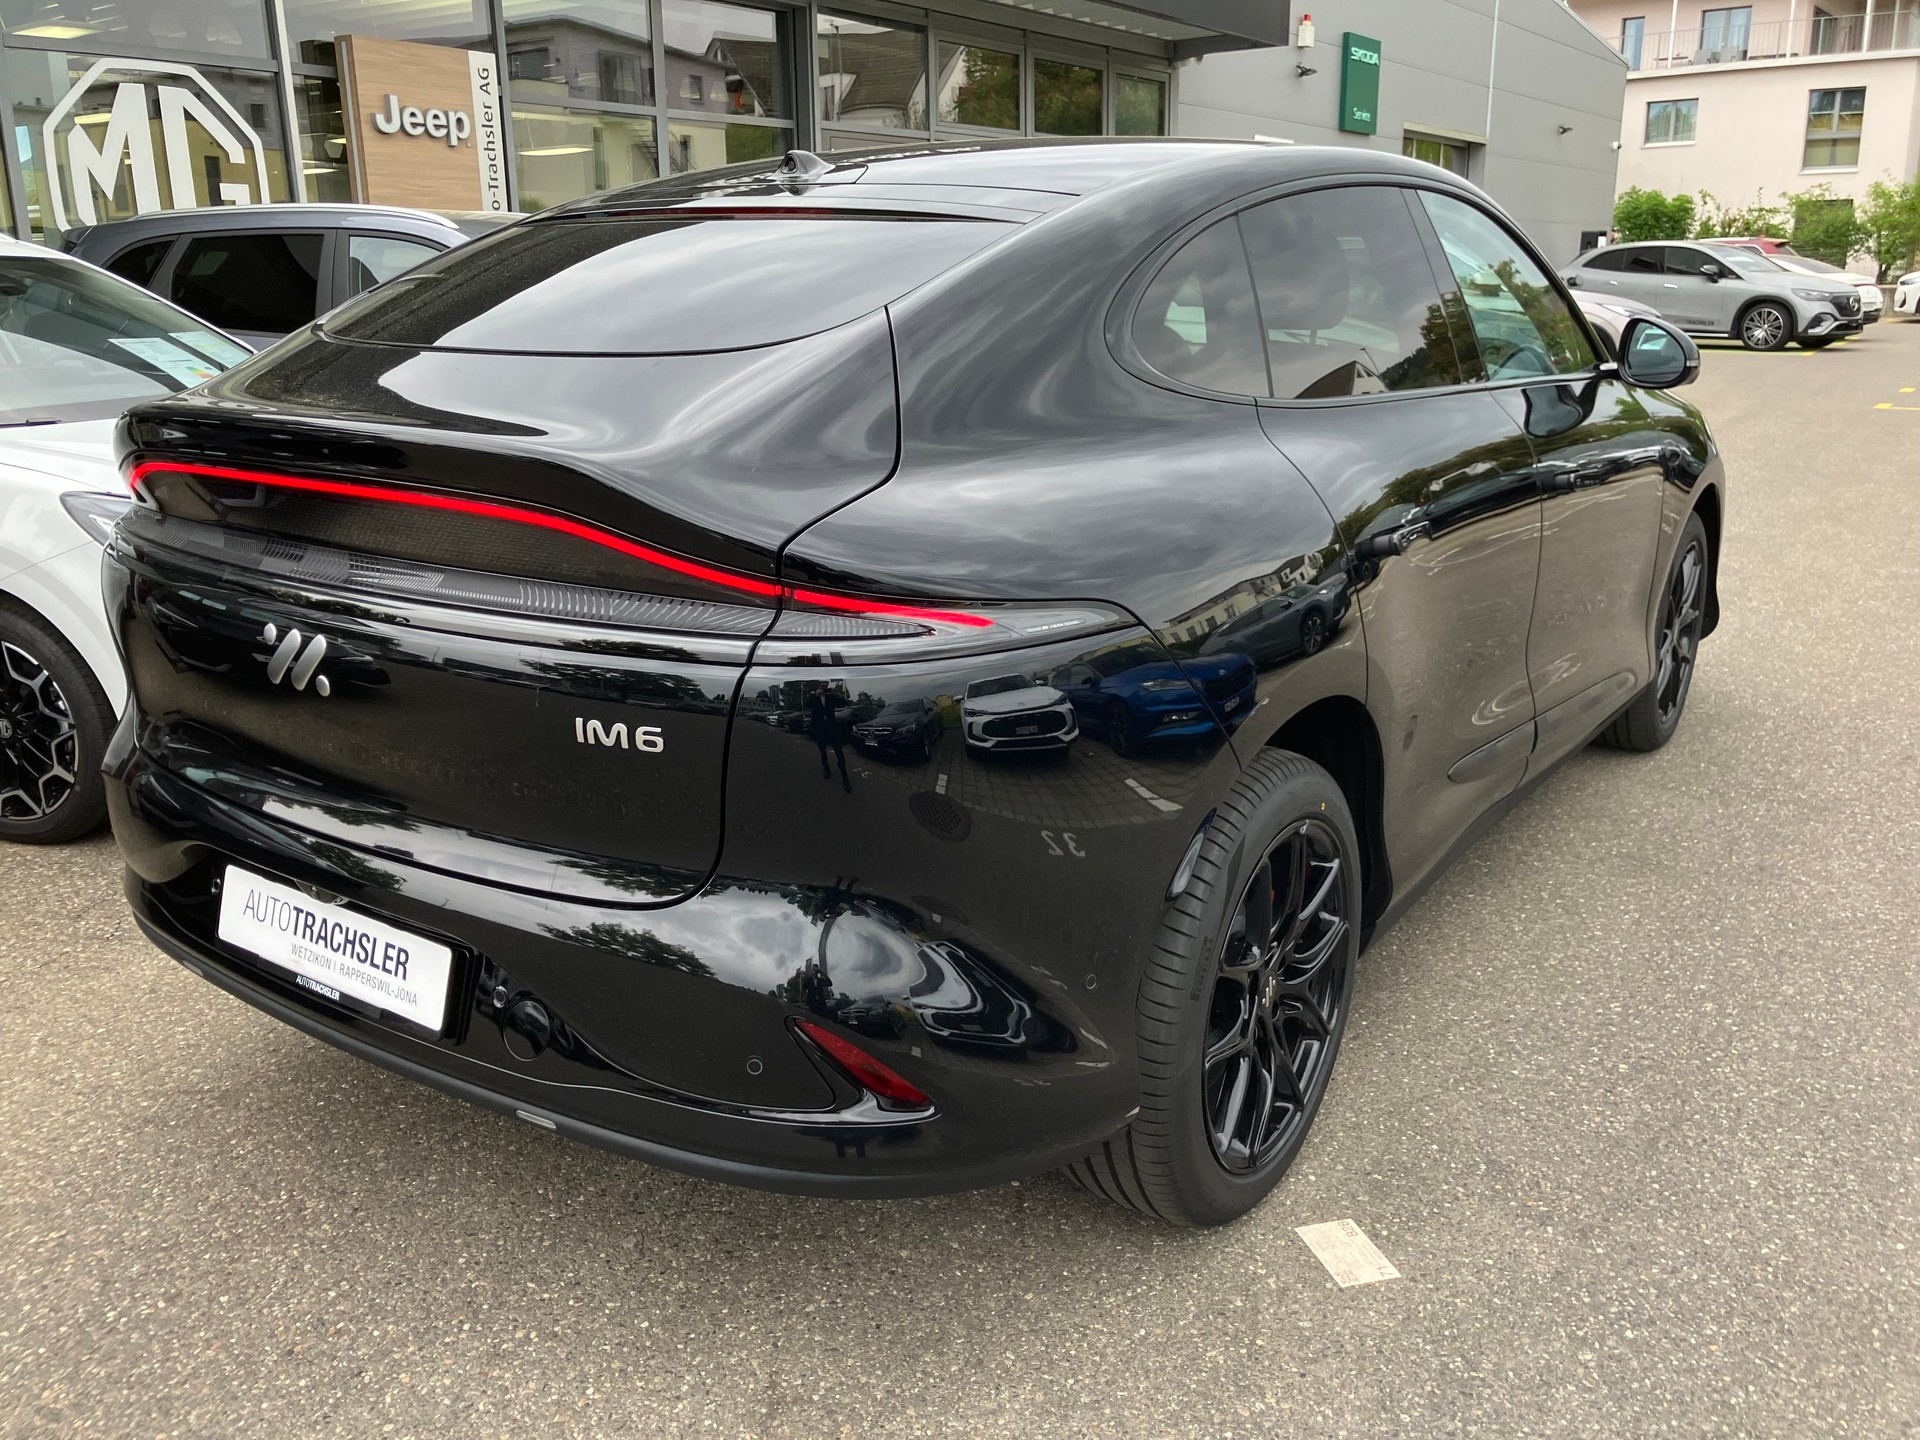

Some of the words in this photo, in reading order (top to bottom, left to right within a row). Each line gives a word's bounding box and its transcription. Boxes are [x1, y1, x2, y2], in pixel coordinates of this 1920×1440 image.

[477, 67, 492, 95] AG
[371, 93, 471, 147] Jeep
[67, 83, 251, 227] MG
[243, 889, 410, 981] AUTOTRACHSLER
[290, 943, 331, 971] WETZIKON
[339, 963, 418, 1007] RAPPERSWIL-JONA
[296, 974, 340, 1001] AUTOTRACHSLER
[1337, 1220, 1358, 1237] 828
